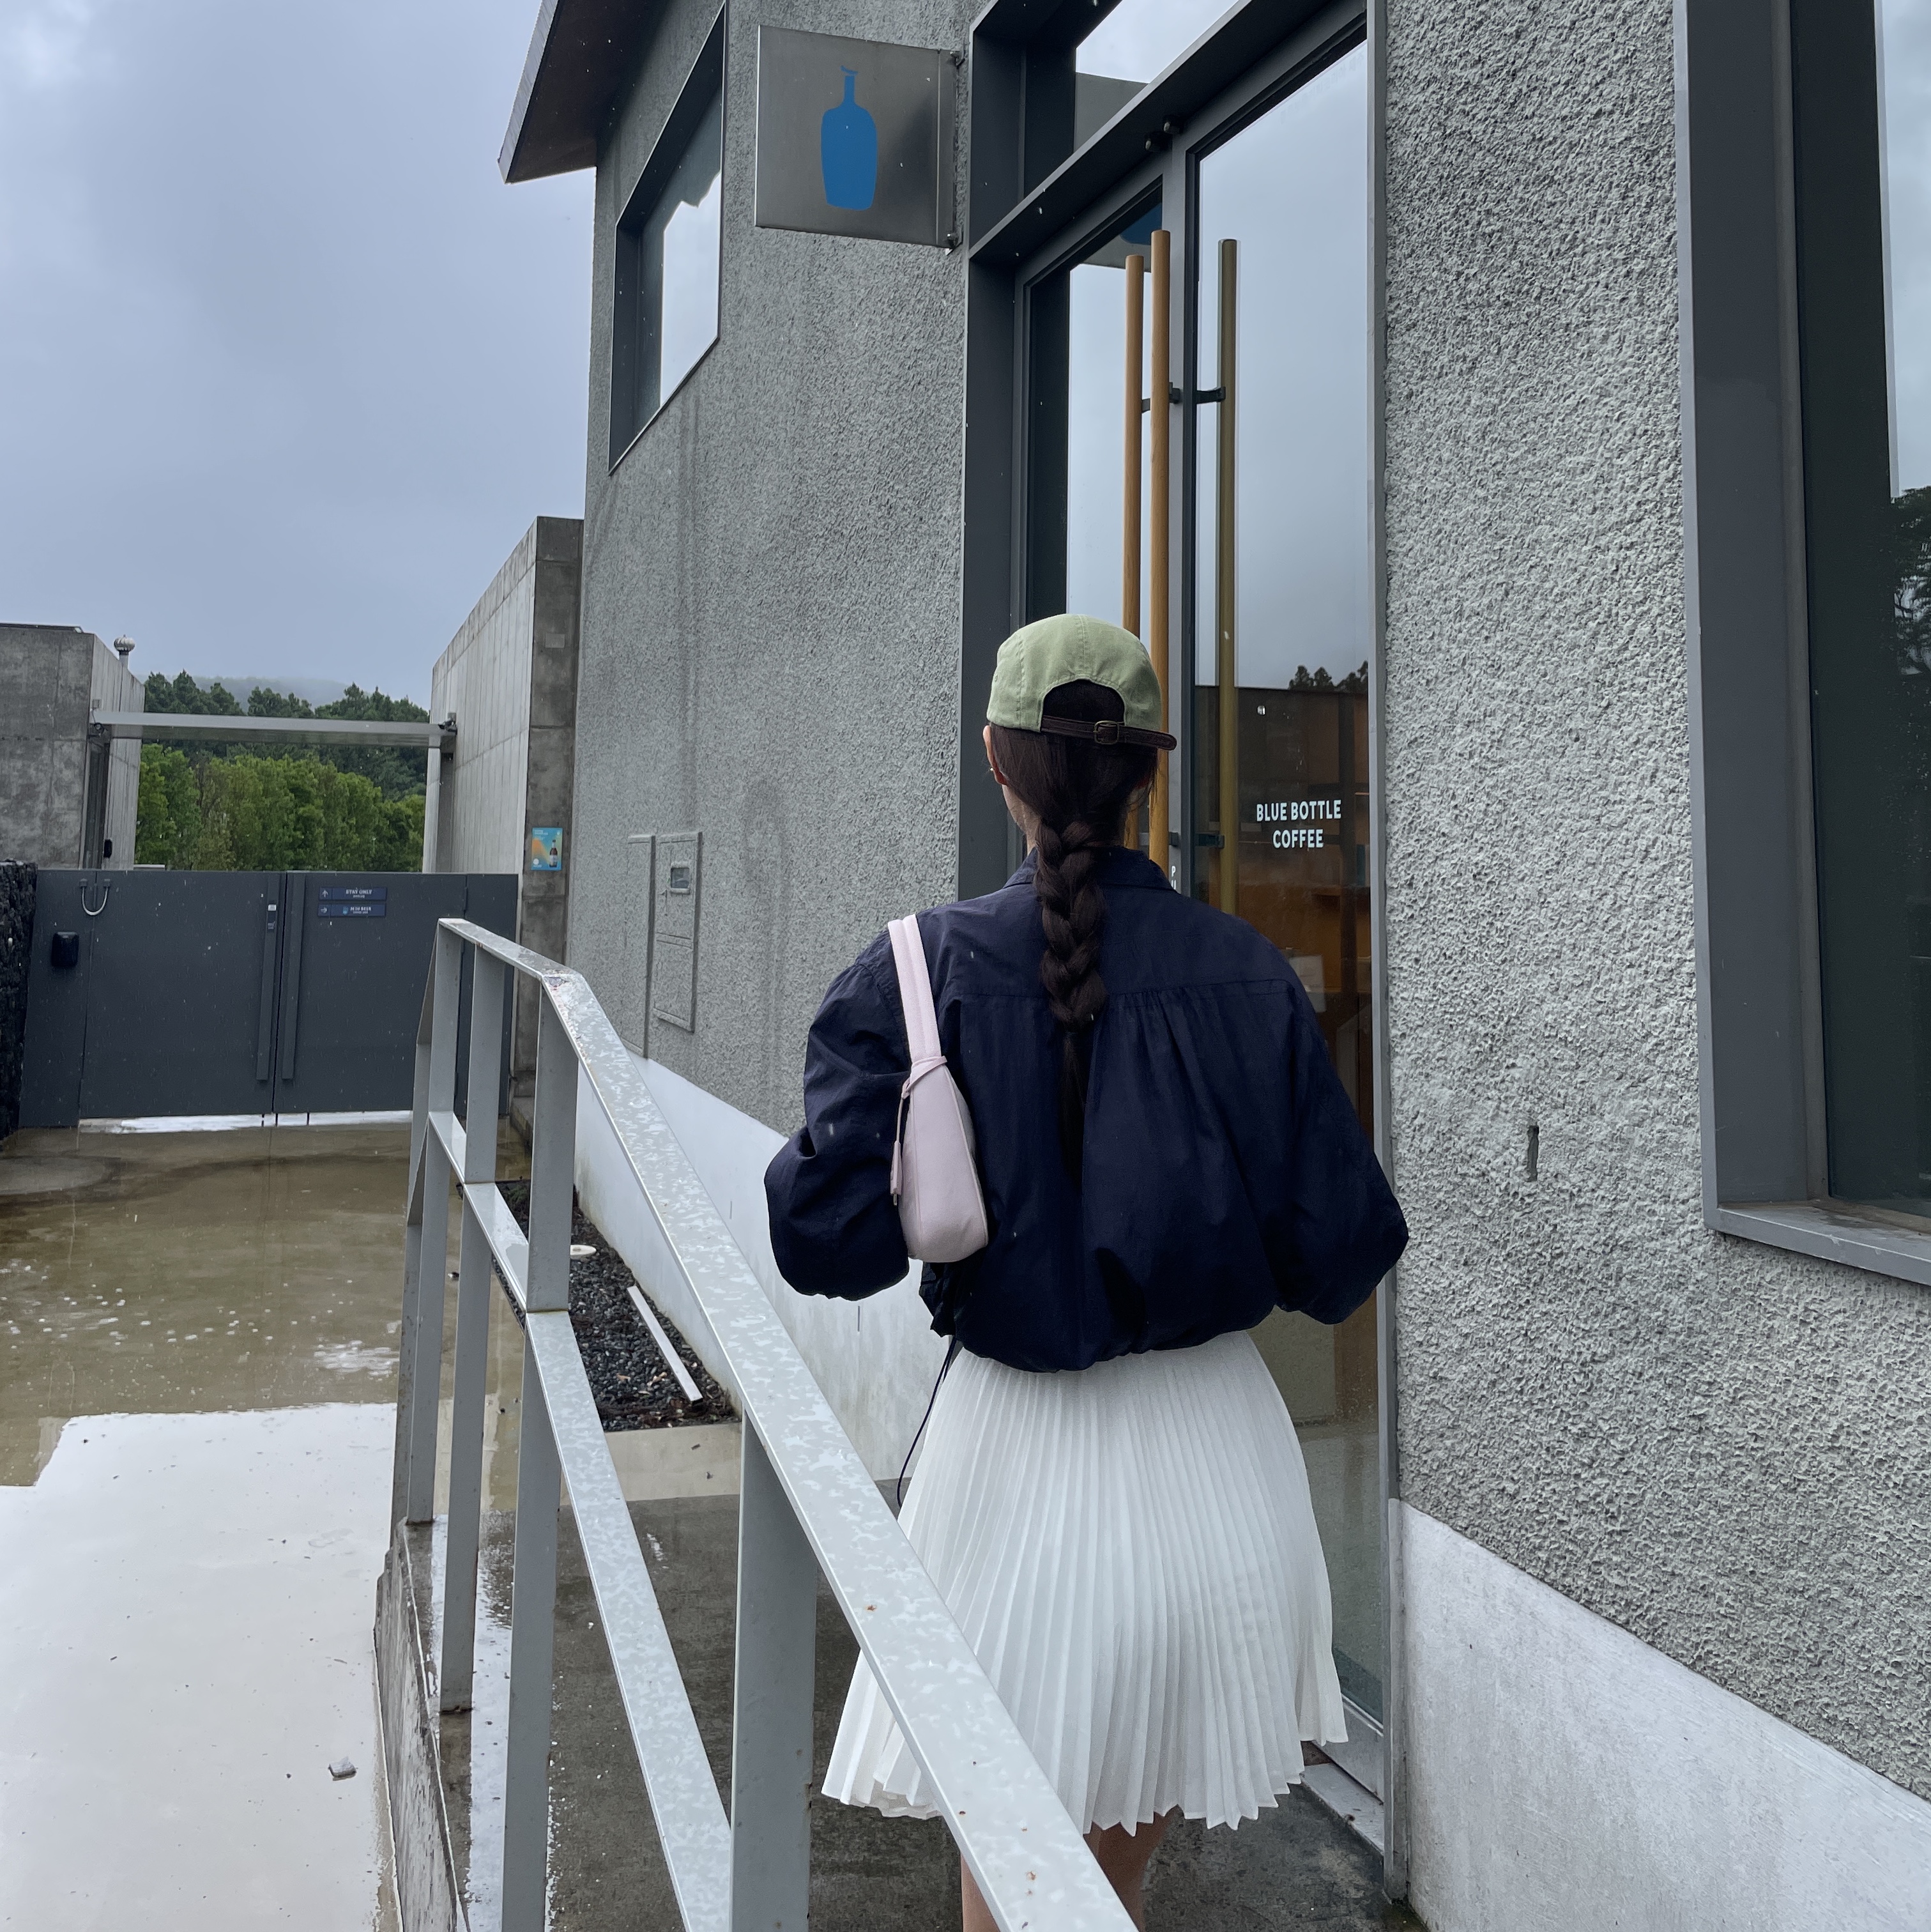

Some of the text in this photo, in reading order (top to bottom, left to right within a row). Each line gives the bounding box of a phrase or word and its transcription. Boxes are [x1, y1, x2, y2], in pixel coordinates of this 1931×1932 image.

[1256, 799, 1341, 822] BLUE BOTTLE
[1272, 829, 1324, 848] COFFEE
